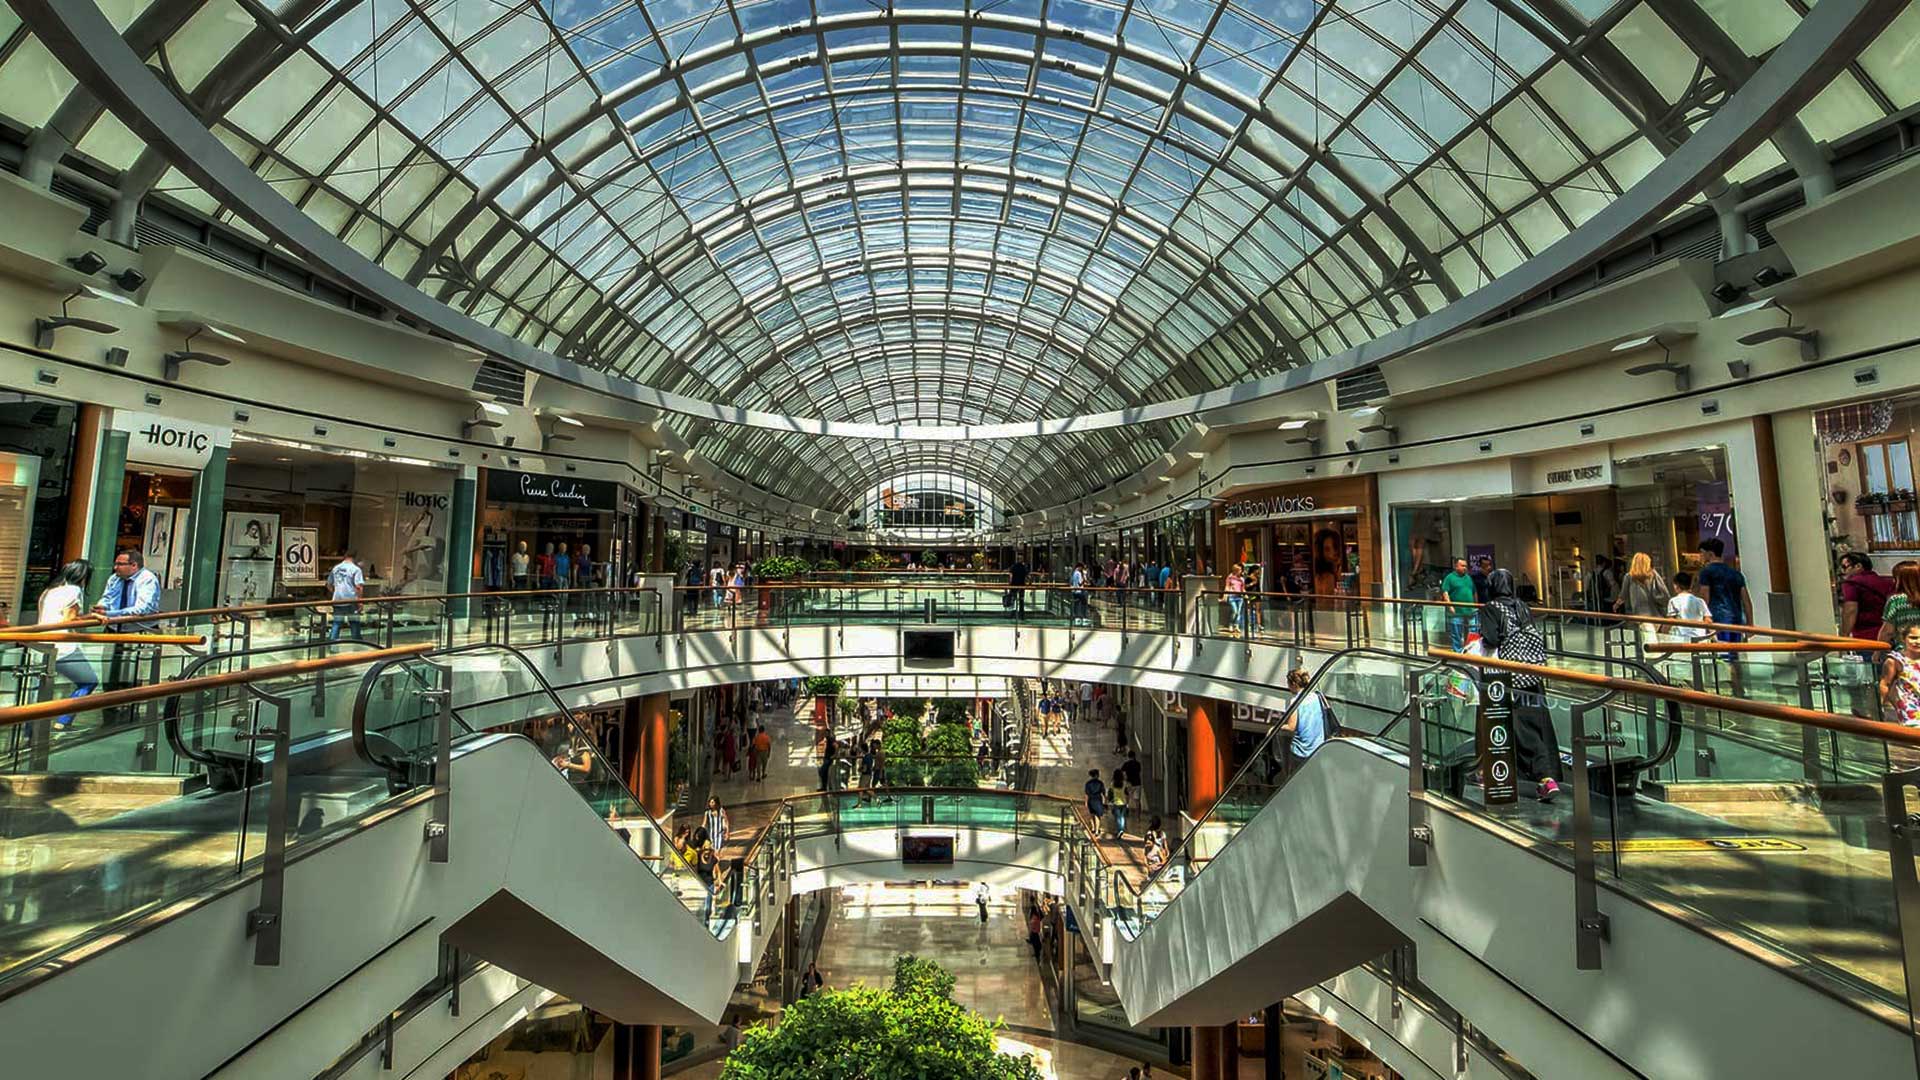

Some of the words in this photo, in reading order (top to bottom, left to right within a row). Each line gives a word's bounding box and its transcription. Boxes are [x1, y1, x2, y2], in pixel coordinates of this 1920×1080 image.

[520, 473, 548, 497] Pierre
[551, 479, 588, 507] Cardin
[1244, 499, 1270, 519] Body
[1270, 493, 1314, 513] Works
[286, 543, 313, 565] 60
